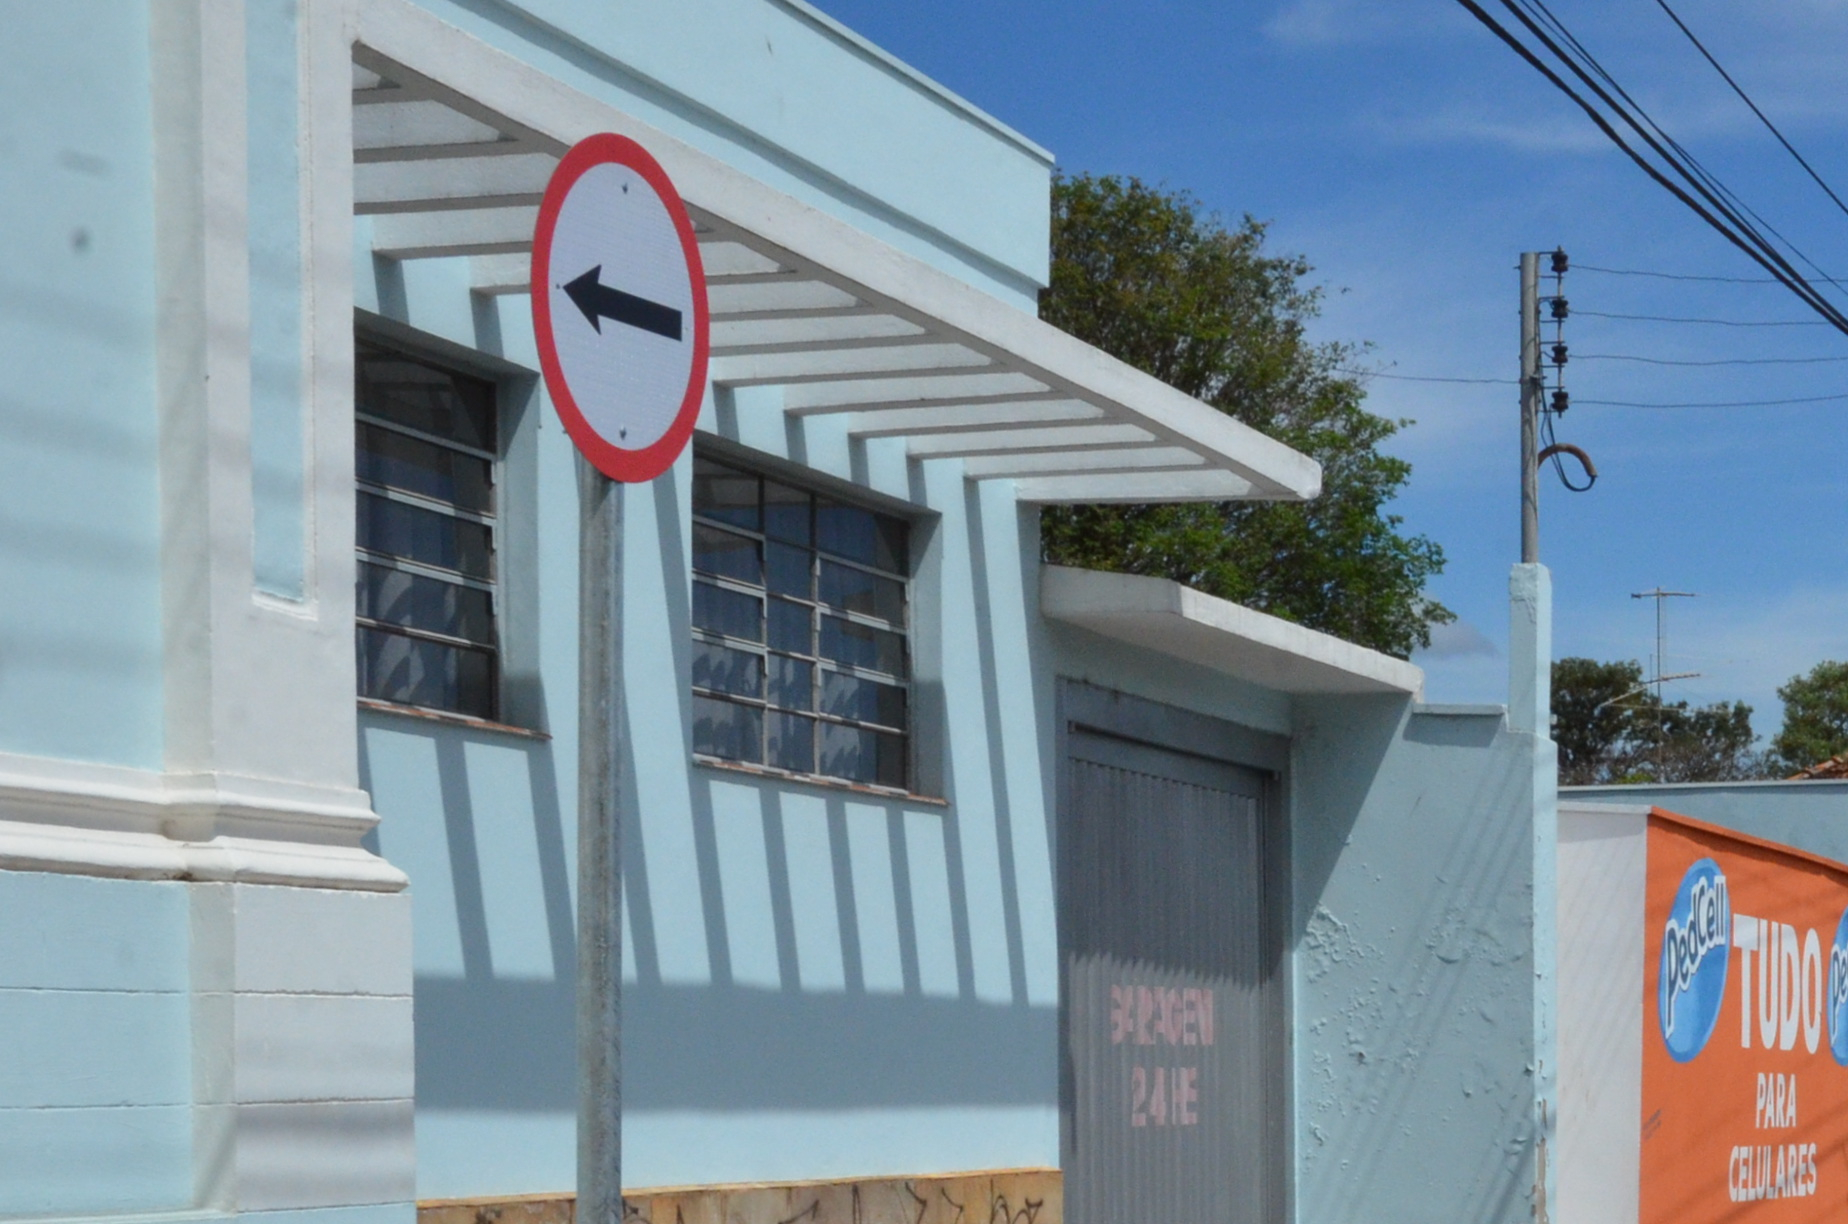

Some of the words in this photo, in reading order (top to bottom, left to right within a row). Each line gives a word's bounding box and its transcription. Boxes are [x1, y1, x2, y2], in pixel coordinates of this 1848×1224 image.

[1733, 914, 1822, 1054] TUDO
[1755, 1073, 1796, 1128] PARA
[1729, 1143, 1816, 1202] CELULARES
